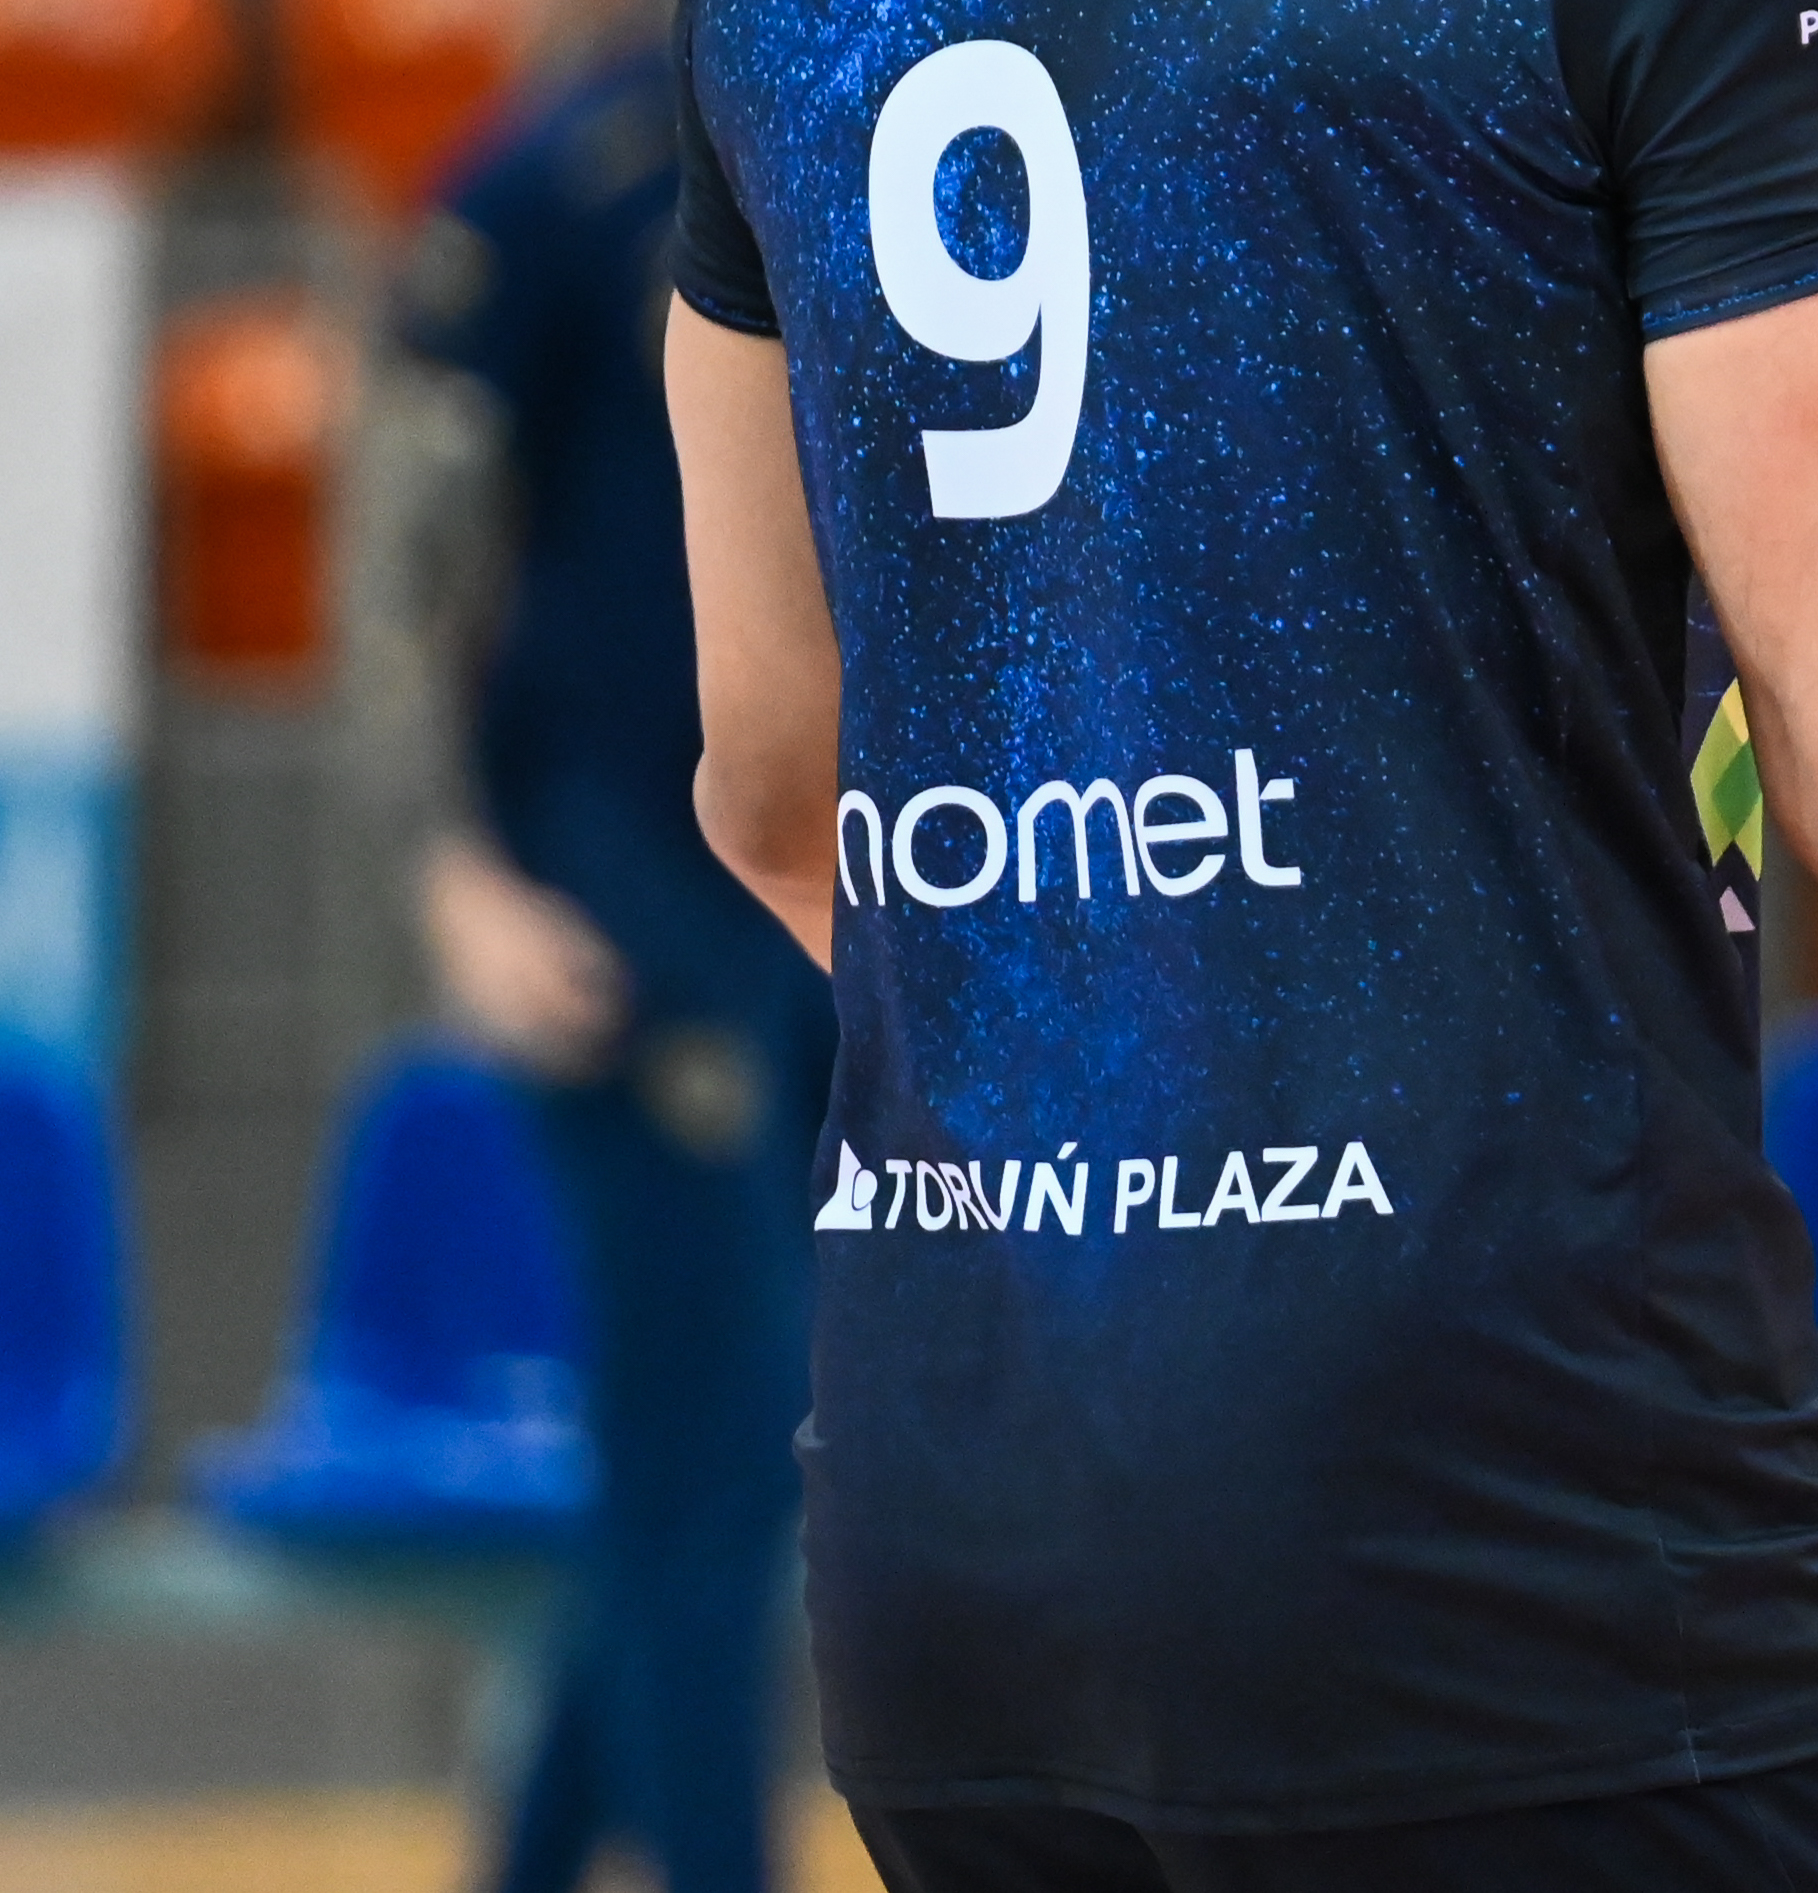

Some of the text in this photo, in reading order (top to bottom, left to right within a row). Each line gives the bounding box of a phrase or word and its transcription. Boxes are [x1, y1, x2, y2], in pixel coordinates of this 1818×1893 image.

[867, 38, 1091, 519] 9
[884, 1140, 1394, 1236] TORUŃ PLAZA
